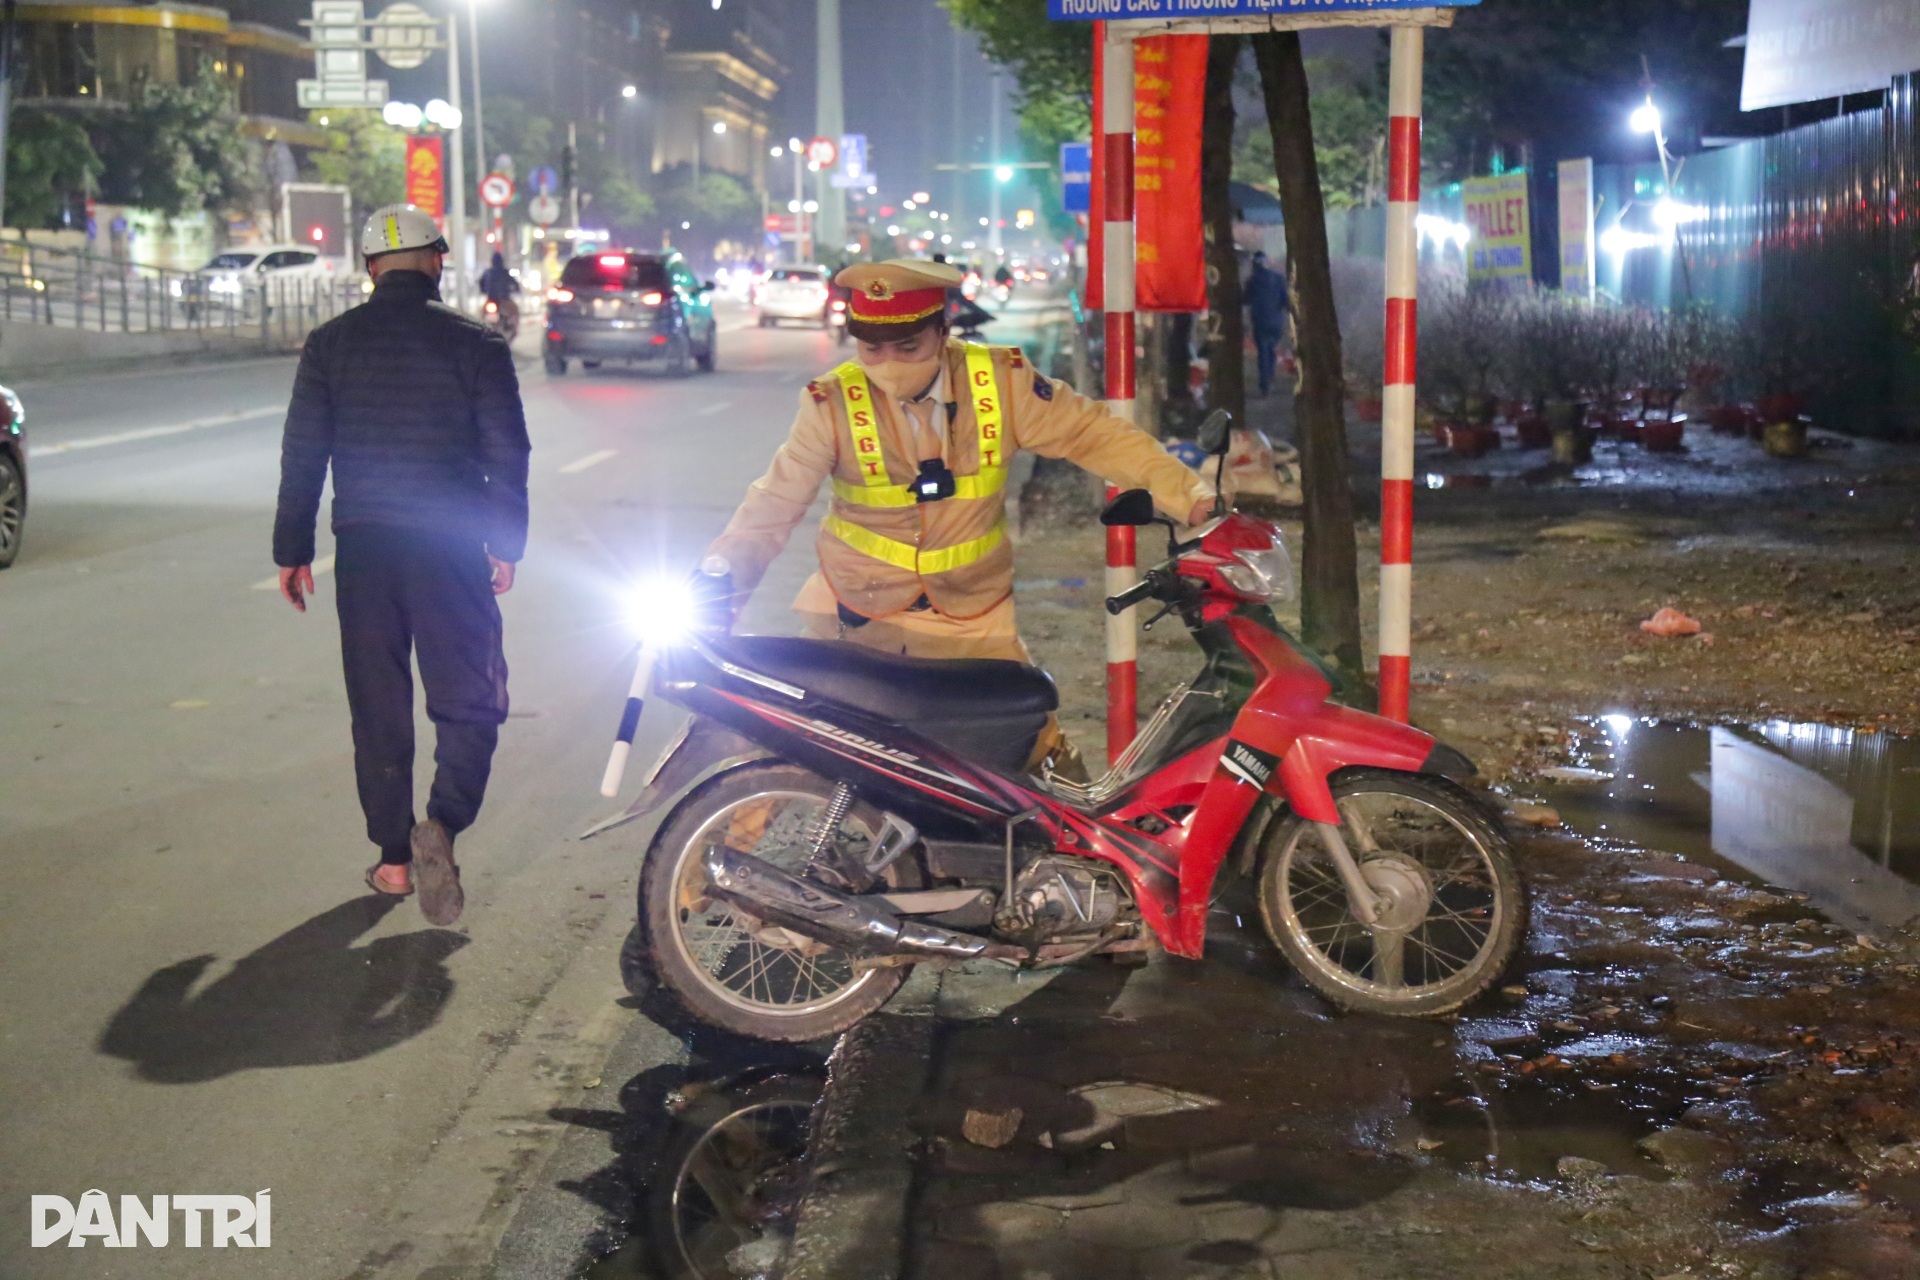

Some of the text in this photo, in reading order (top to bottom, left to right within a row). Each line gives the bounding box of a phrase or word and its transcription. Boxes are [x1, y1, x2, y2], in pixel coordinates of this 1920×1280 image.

[1466, 198, 1524, 237] PALLET
[847, 385, 879, 475] CSGT
[974, 370, 997, 466] CSGT
[812, 720, 919, 762] SIRIUS
[1232, 744, 1271, 783] YAMAHA
